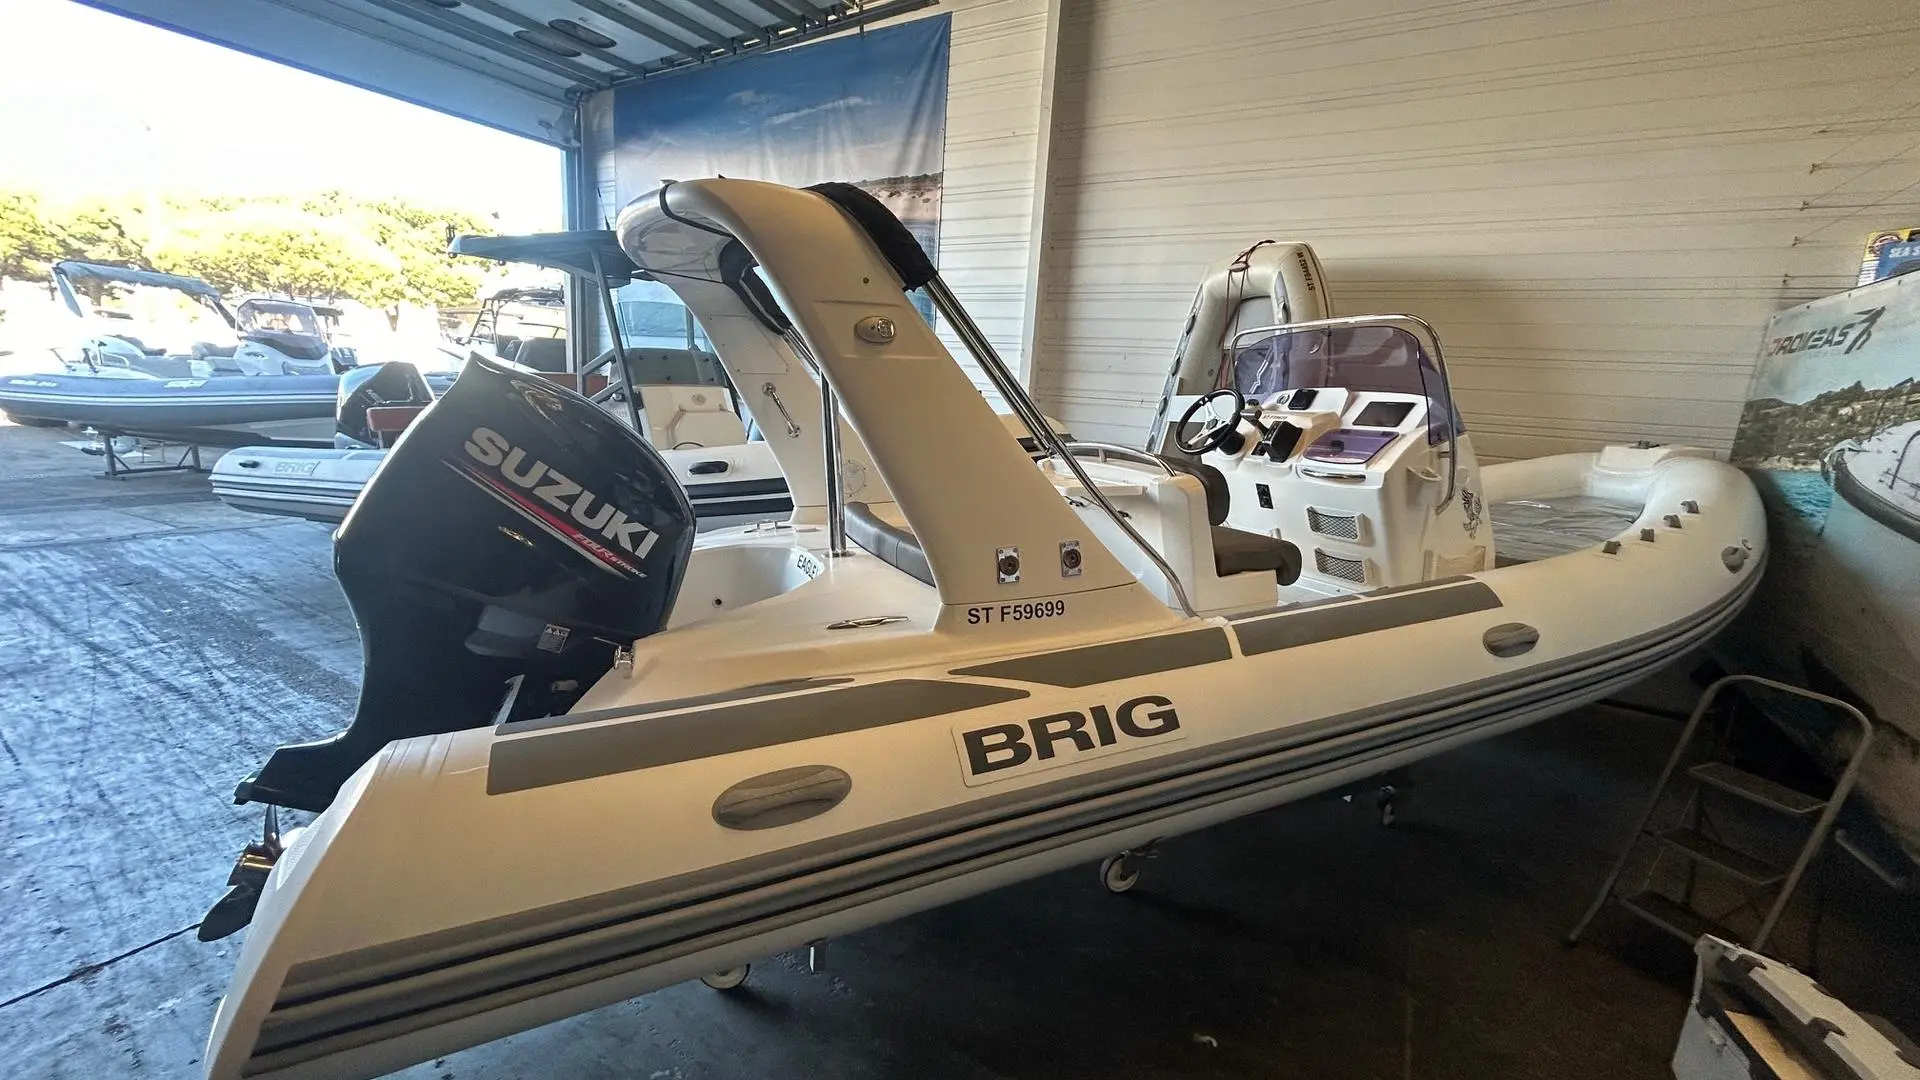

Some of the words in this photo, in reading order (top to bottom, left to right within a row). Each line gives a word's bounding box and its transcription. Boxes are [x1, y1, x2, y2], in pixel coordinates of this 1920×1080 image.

[276, 461, 315, 474] BRIG
[464, 427, 659, 560] SUZUKI
[967, 606, 994, 625] ST
[1000, 600, 1065, 622] F59699
[962, 695, 1181, 776] BRIG
